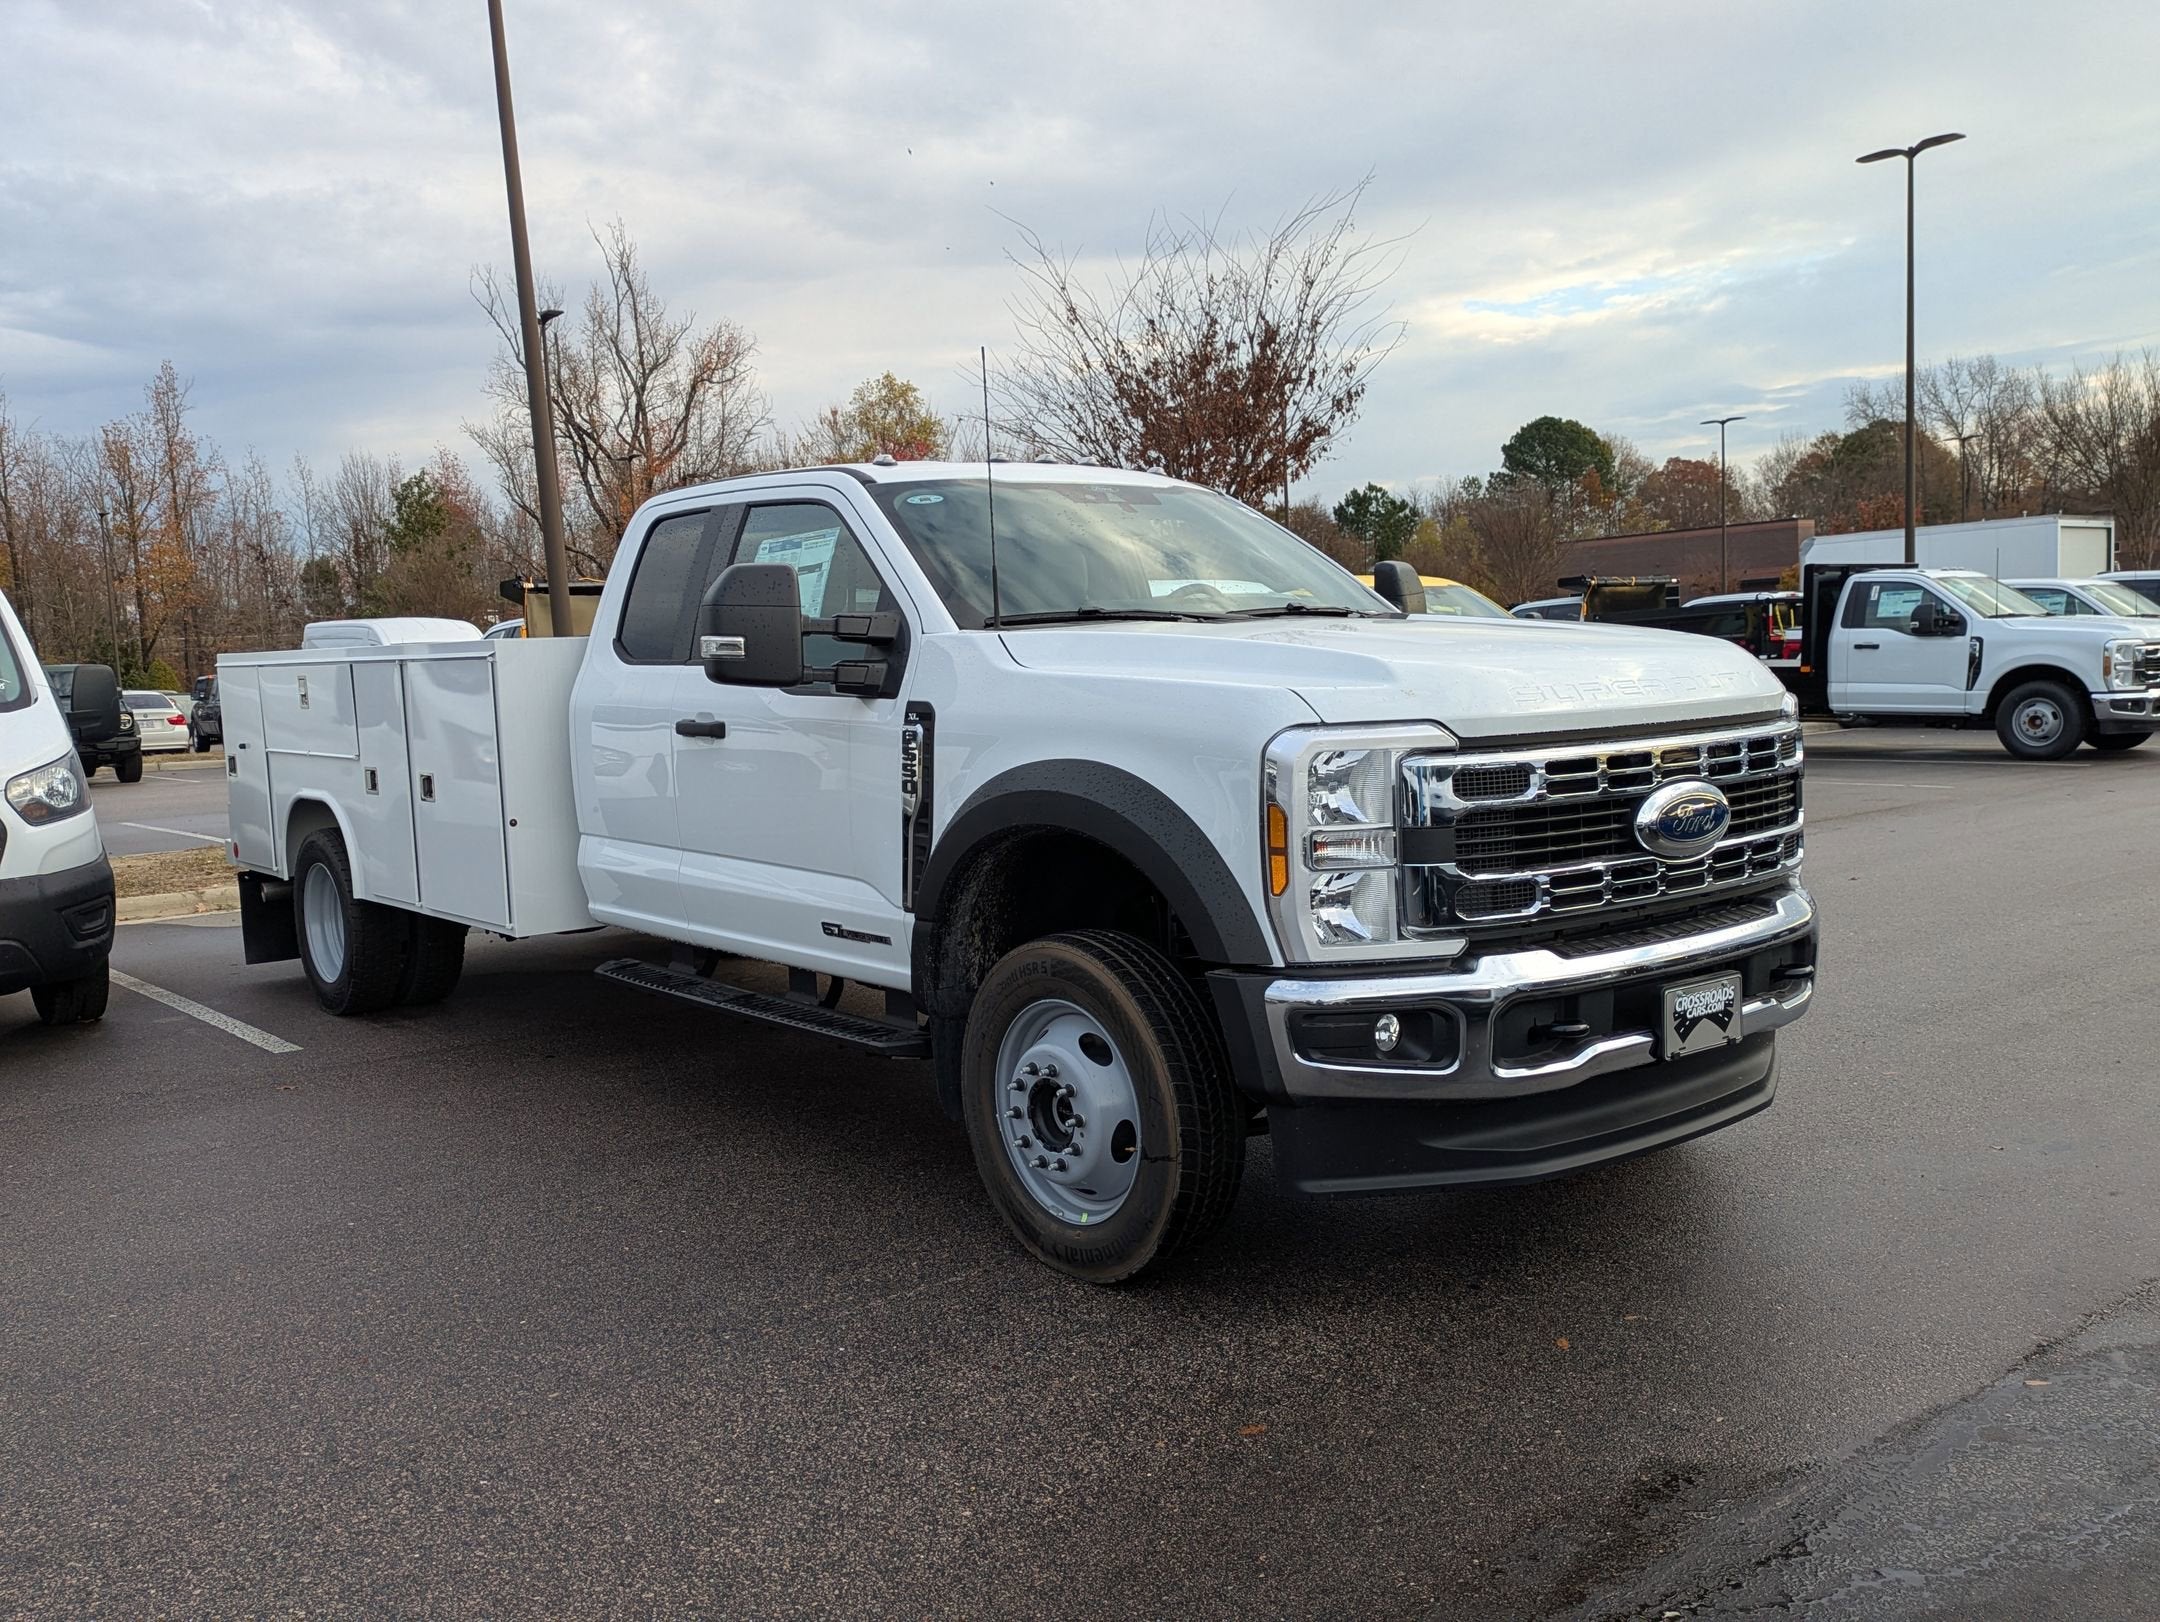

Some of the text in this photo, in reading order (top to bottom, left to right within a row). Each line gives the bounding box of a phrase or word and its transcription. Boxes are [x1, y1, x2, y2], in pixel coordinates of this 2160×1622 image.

[907, 712, 920, 721] XL
[1667, 801, 1718, 836] Ford
[1675, 985, 1735, 1012] CROSSROADS
[1686, 1001, 1725, 1019] CARS.COM
